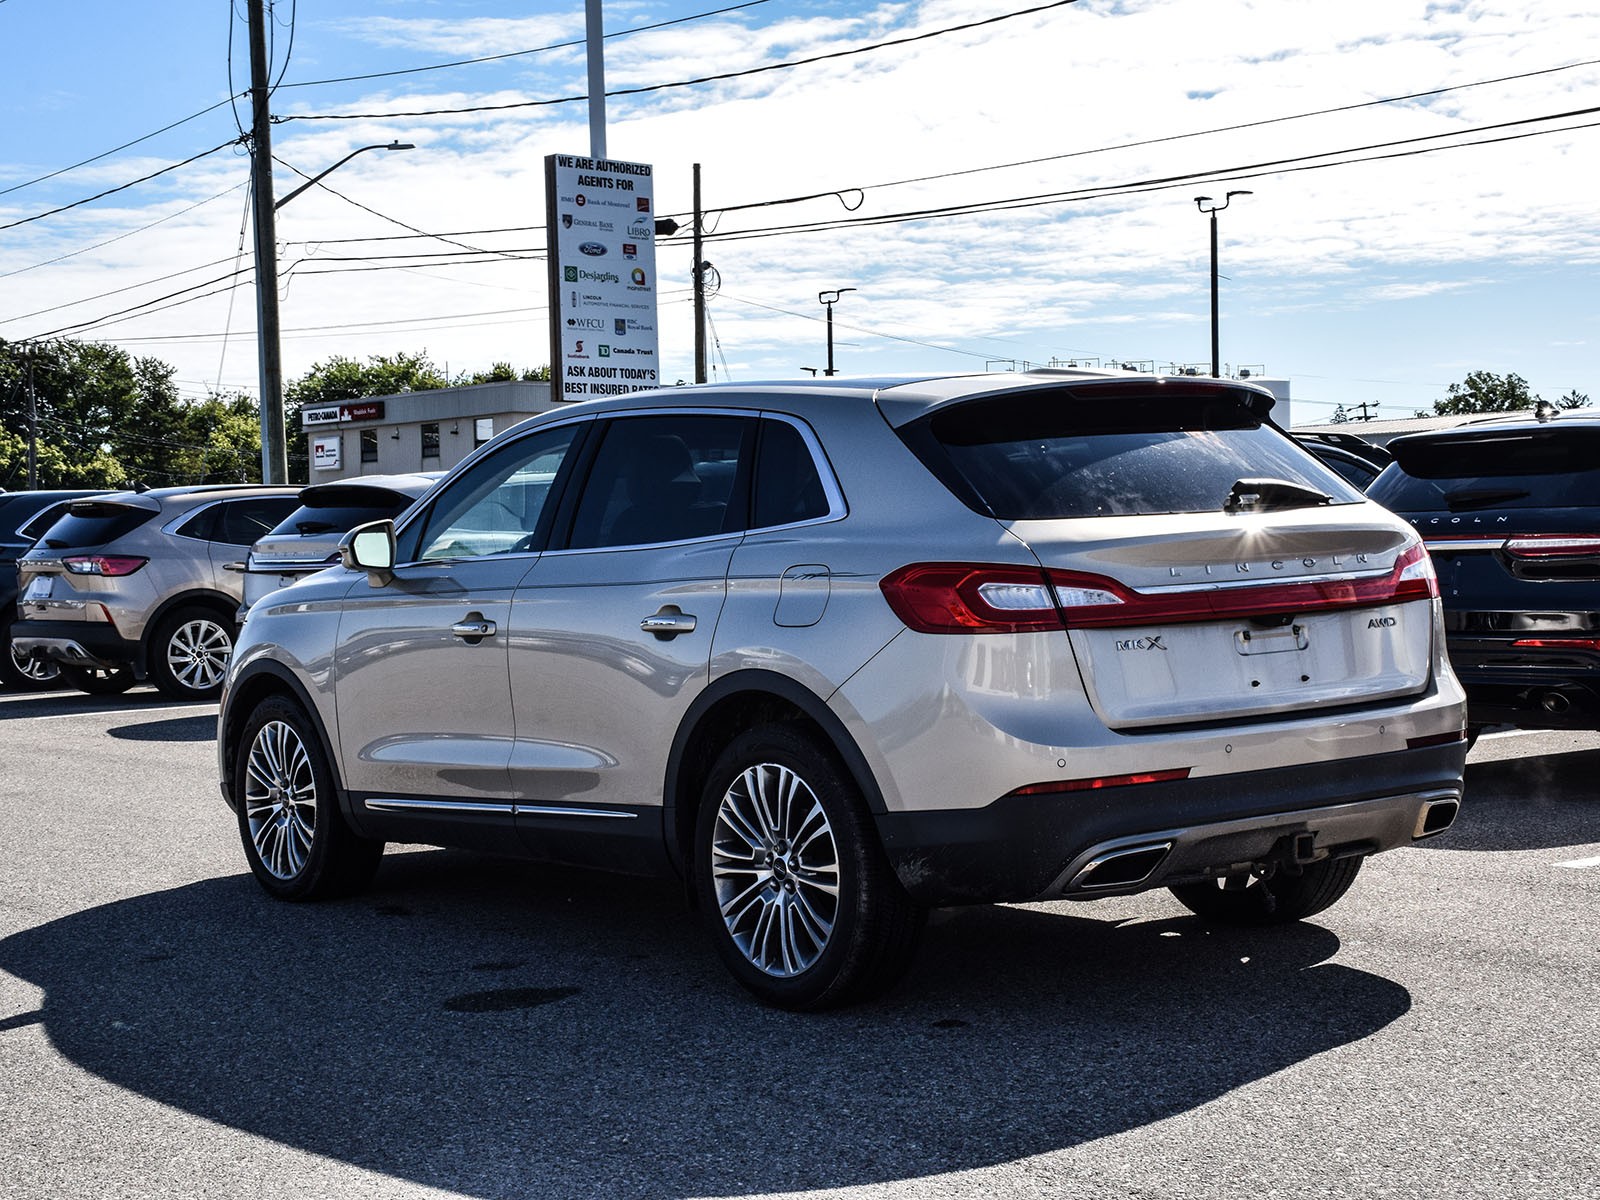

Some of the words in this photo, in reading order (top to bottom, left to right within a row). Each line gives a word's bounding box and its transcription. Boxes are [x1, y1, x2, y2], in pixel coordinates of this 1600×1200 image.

[558, 156, 573, 168] WE
[575, 159, 594, 170] ARE
[596, 161, 651, 176] AUTHORIZED
[578, 175, 613, 189] AGENTS
[616, 179, 634, 191] FOR
[627, 225, 651, 237] LIBRO
[579, 269, 619, 283] Desjardins
[577, 319, 604, 328] WFCU
[599, 346, 609, 356] TD
[613, 347, 635, 355] Canada
[637, 348, 653, 356] Trust
[567, 366, 585, 377] ASK
[588, 366, 617, 378] ABOUT
[619, 368, 656, 380] TODAY'S
[565, 382, 588, 394] BEST
[590, 383, 629, 395] INSURED
[1409, 515, 1508, 525] NCOLN
[1169, 553, 1368, 577] LINCOLN
[1367, 616, 1397, 630] AWD
[1115, 634, 1168, 652] MKX
